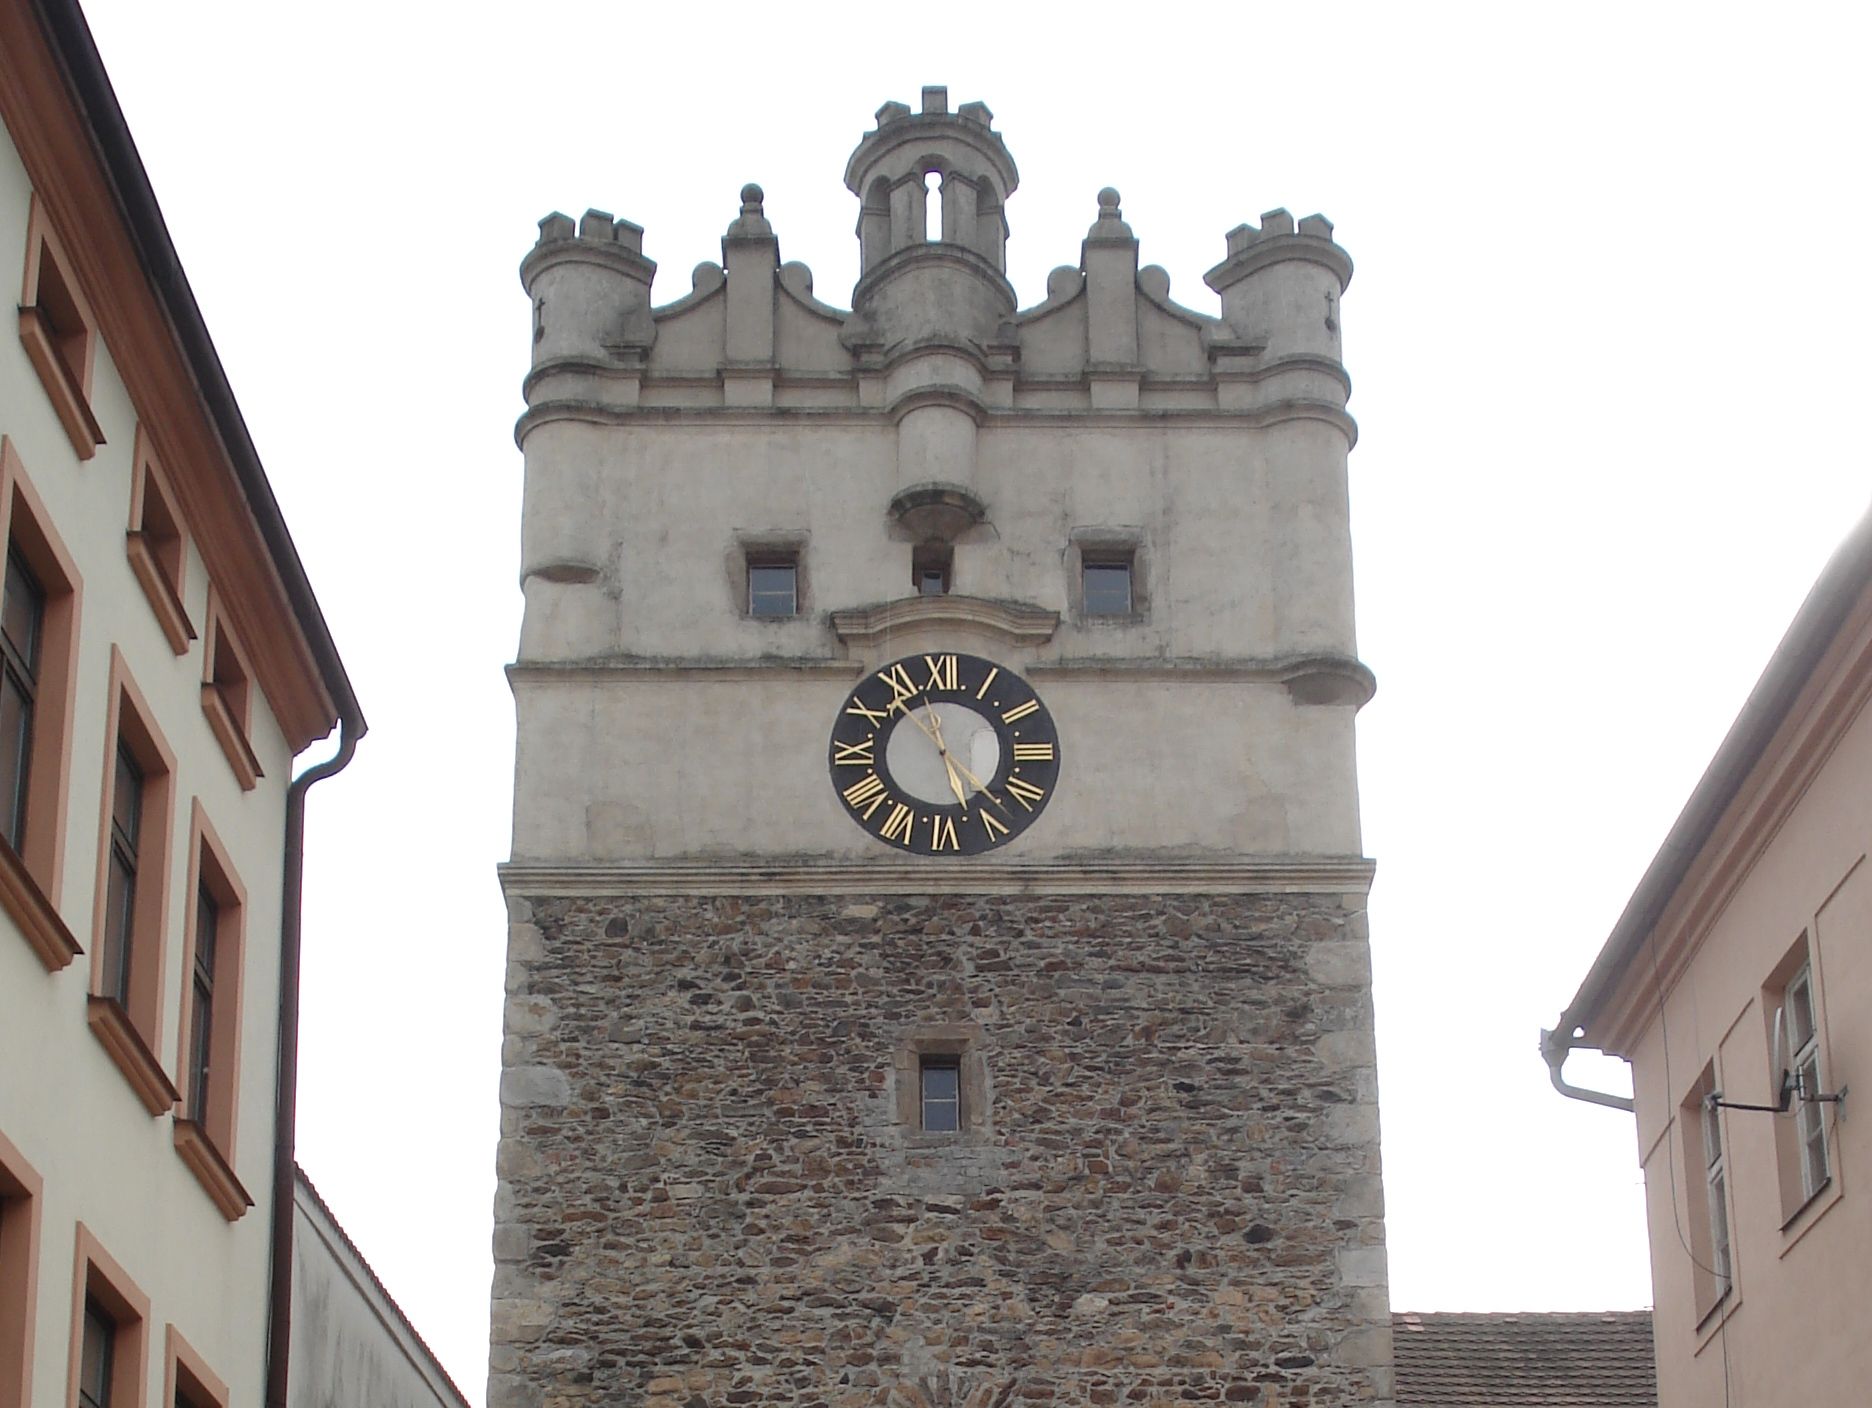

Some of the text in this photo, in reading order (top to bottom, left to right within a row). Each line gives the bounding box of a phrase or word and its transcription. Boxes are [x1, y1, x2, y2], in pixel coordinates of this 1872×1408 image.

[877, 663, 919, 701] XI
[924, 655, 958, 691] XII
[845, 696, 889, 729] X
[834, 739, 875, 765] IX
[1013, 743, 1053, 761] III
[842, 773, 889, 822] VIII
[1005, 776, 1045, 813] IV
[879, 803, 915, 846] VII
[931, 815, 960, 850] VI
[979, 808, 1011, 843] V
